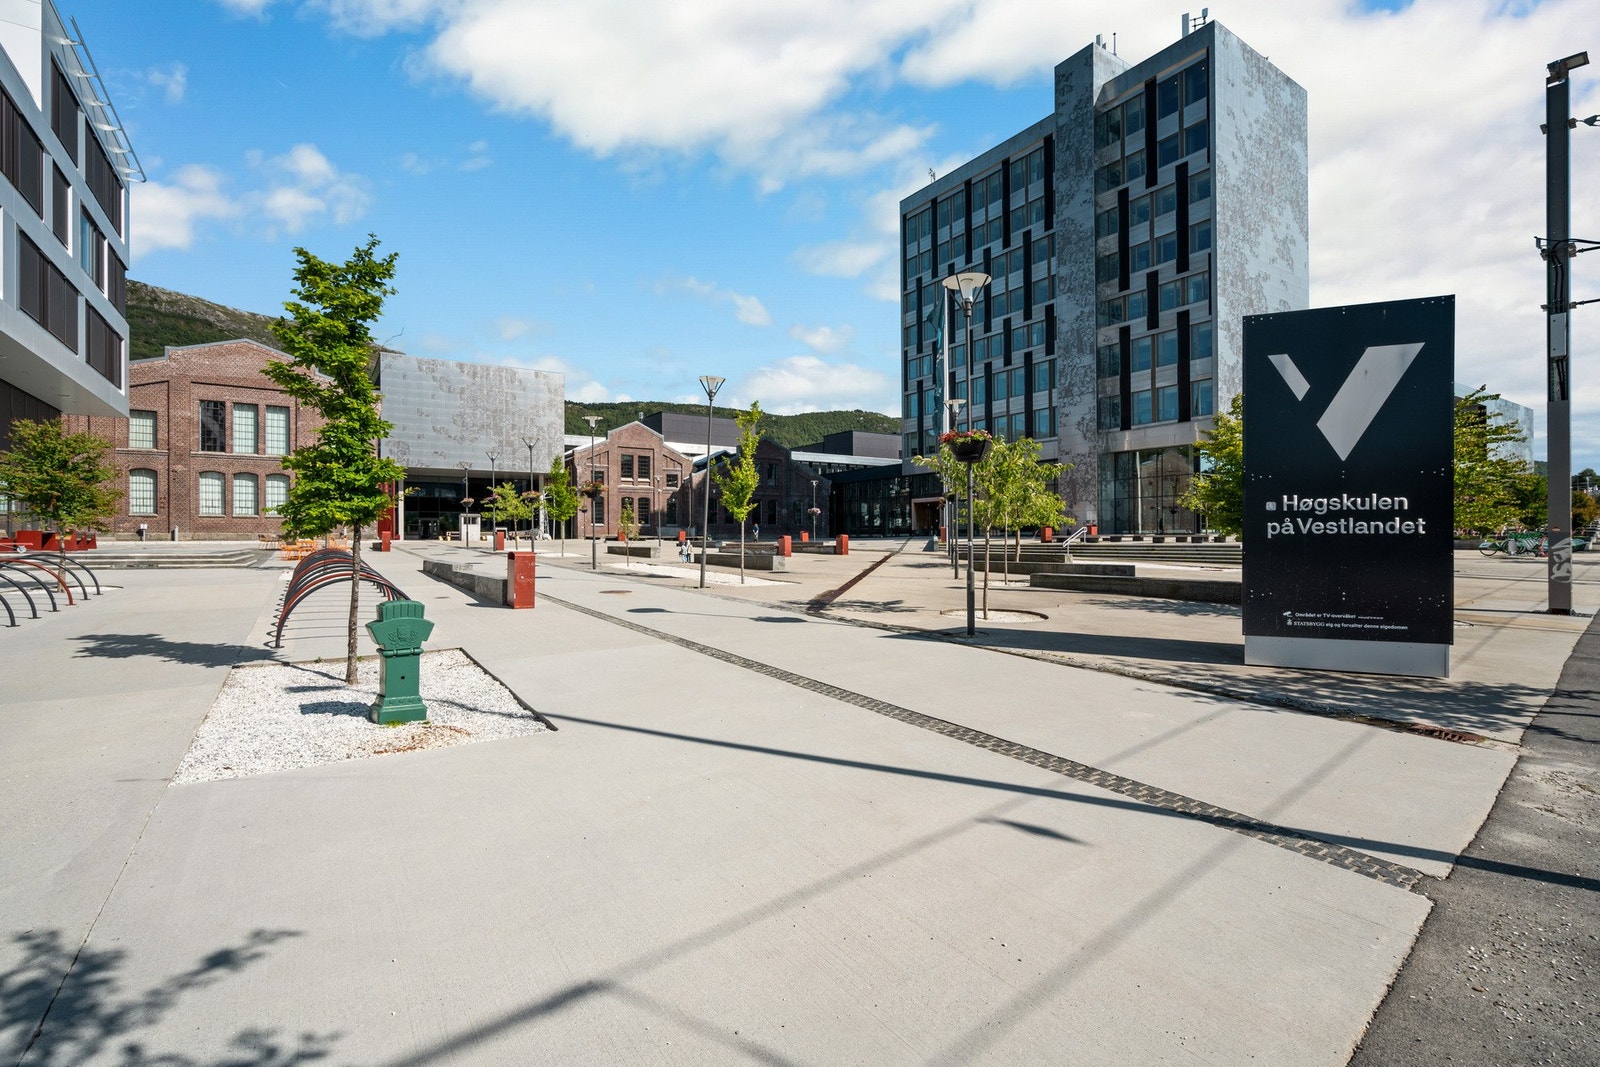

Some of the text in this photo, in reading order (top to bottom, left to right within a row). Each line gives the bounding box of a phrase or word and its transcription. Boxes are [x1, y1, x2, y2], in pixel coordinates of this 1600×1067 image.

[1282, 493, 1408, 515] Høgskulen
[1267, 517, 1426, 538] på Vestlandet
